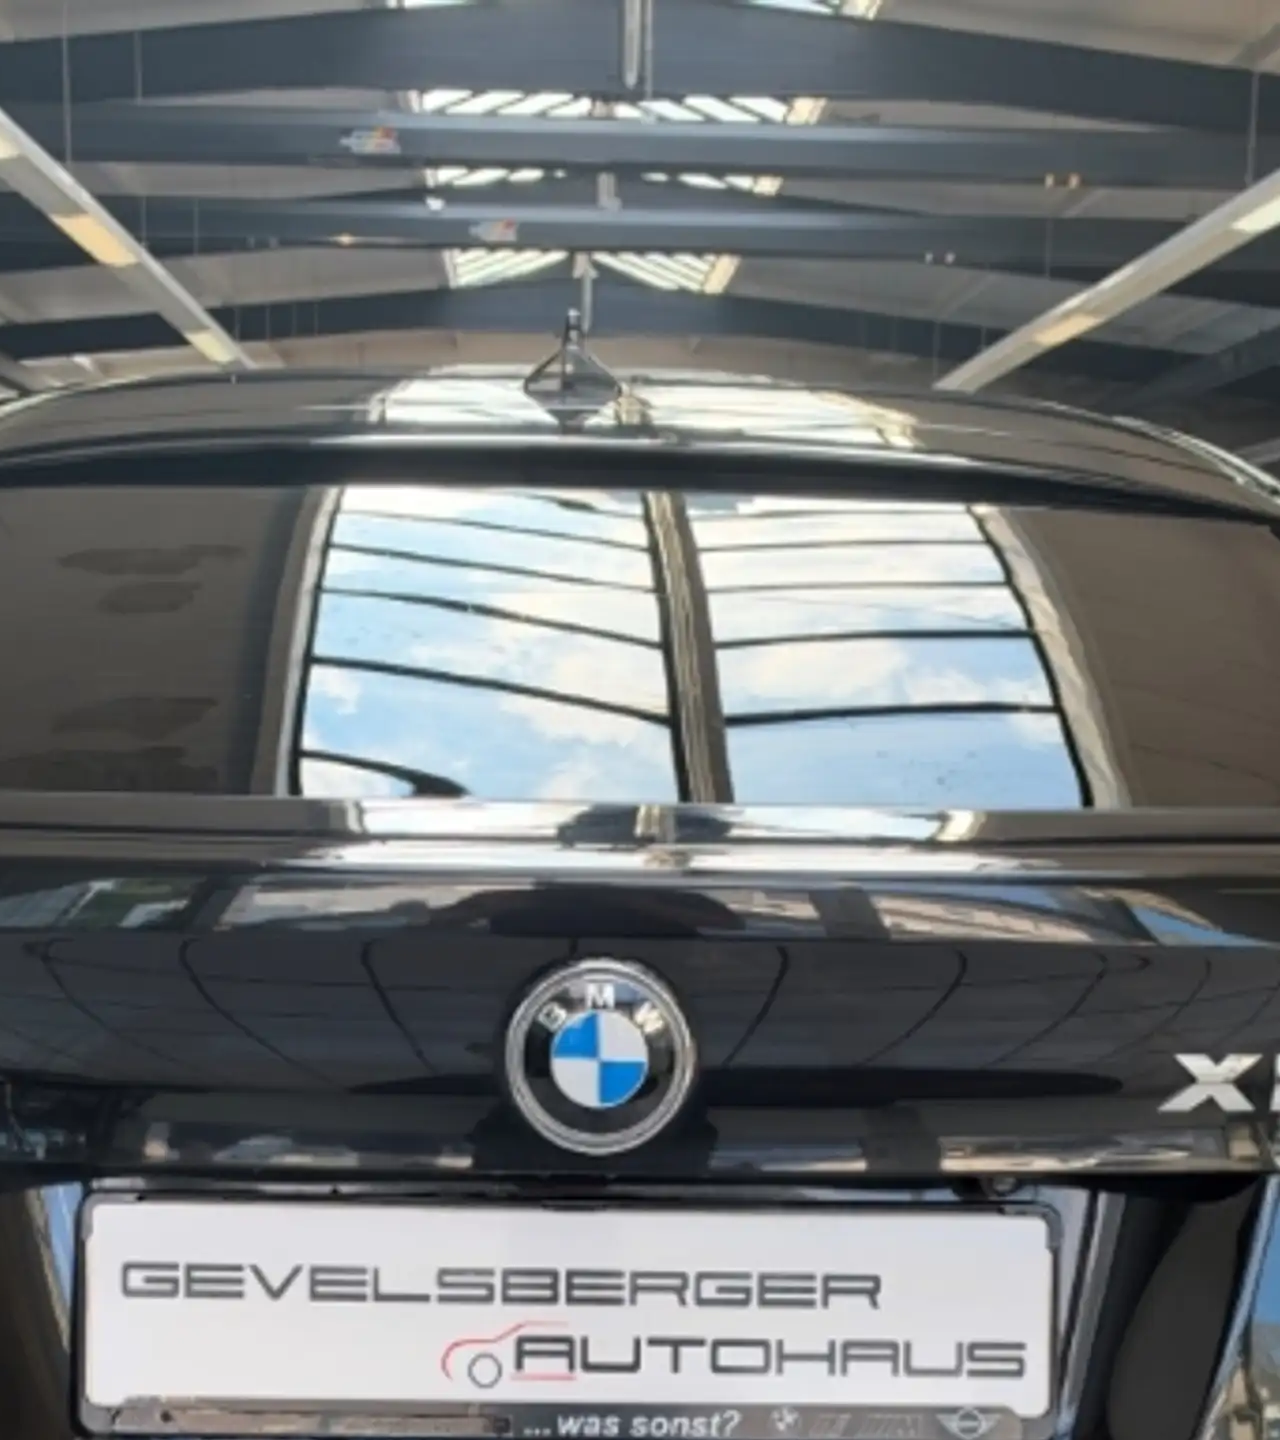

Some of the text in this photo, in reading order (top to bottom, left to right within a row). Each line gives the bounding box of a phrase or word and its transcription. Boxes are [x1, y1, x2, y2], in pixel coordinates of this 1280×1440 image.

[538, 983, 663, 1033] BMW
[121, 1262, 881, 1310] GEVELSBERGER
[516, 1335, 1027, 1379] AUTOHAUS
[629, 1409, 742, 1438] sonst?
